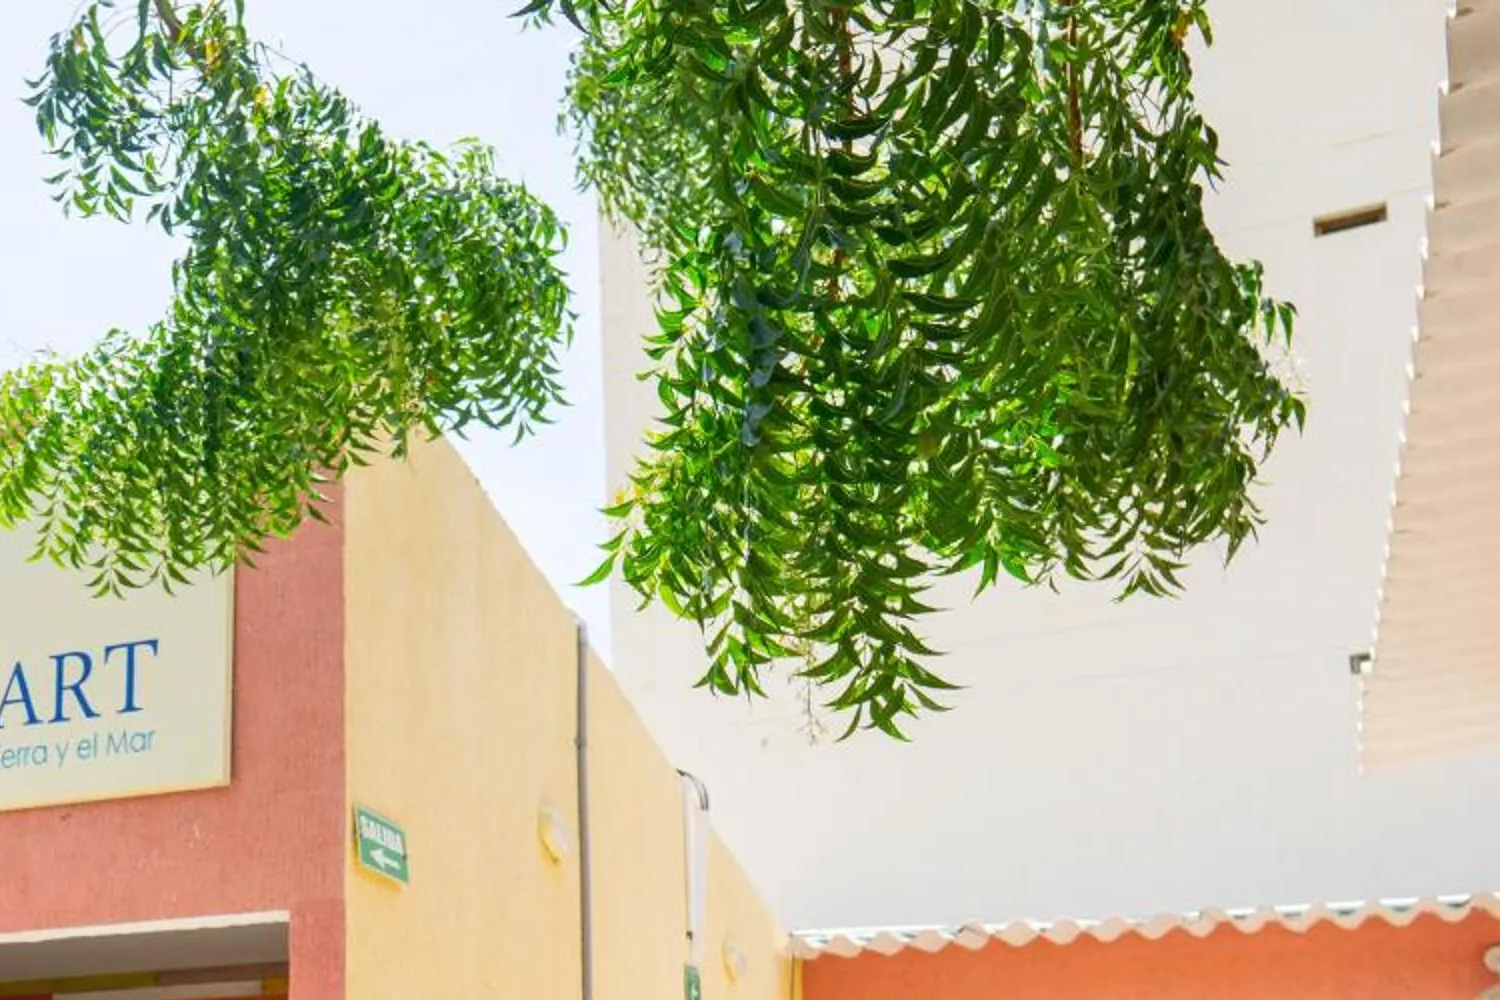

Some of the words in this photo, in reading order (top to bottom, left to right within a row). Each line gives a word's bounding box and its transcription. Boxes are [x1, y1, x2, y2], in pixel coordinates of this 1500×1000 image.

[55, 741, 70, 768] y
[77, 733, 99, 760] el
[106, 728, 157, 755] Mar
